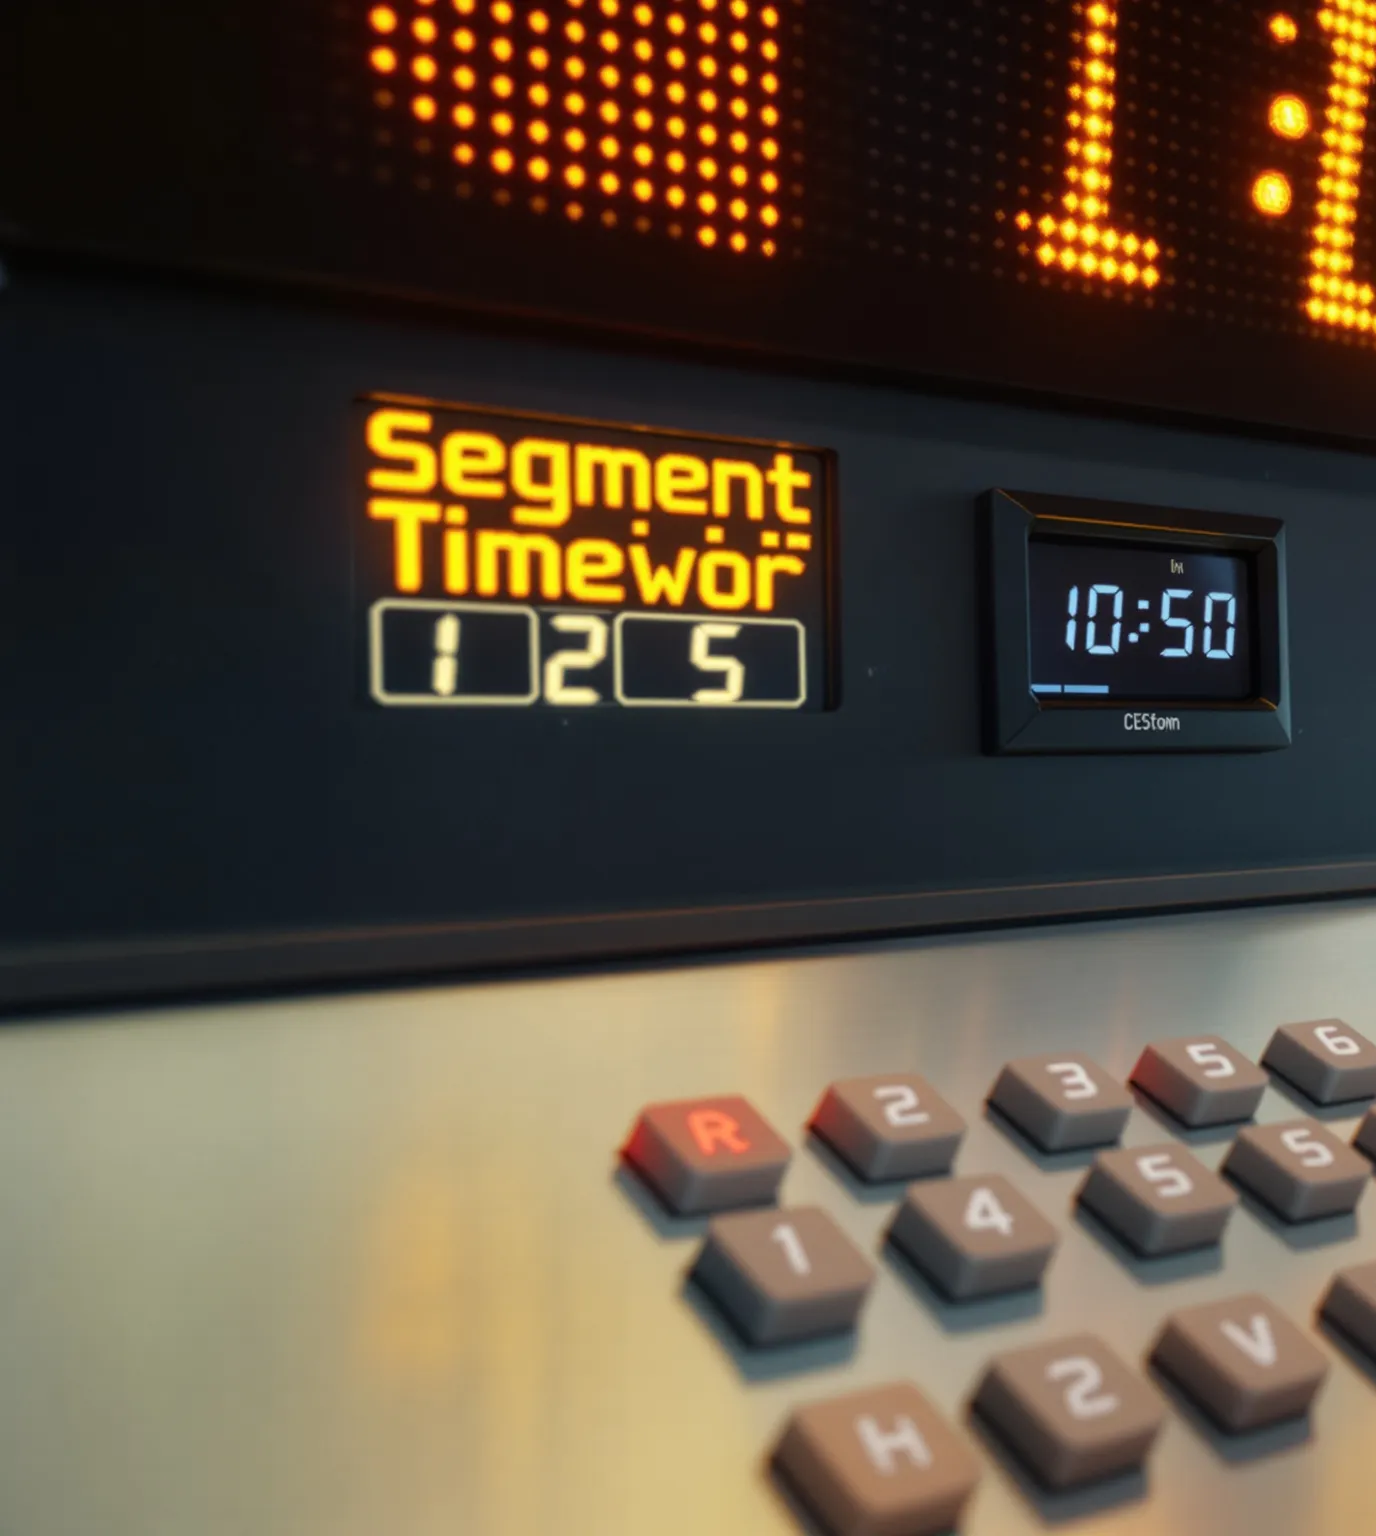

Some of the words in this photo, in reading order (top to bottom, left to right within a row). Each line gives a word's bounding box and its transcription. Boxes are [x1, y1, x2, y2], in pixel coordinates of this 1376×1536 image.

[366, 408, 812, 528] Segment
[543, 613, 609, 706] 2
[689, 623, 745, 704] 5
[687, 1109, 751, 1156] R
[874, 1084, 929, 1126] 2
[1046, 1061, 1097, 1099] 3
[1186, 1043, 1235, 1078] 5
[1313, 1025, 1360, 1056] 6
[772, 1224, 810, 1275] 1
[964, 1187, 1014, 1235] 4
[1136, 1154, 1193, 1197] 5
[1281, 1128, 1335, 1168] 5
[1046, 1355, 1117, 1418] 2
[1220, 1314, 1278, 1367] V
